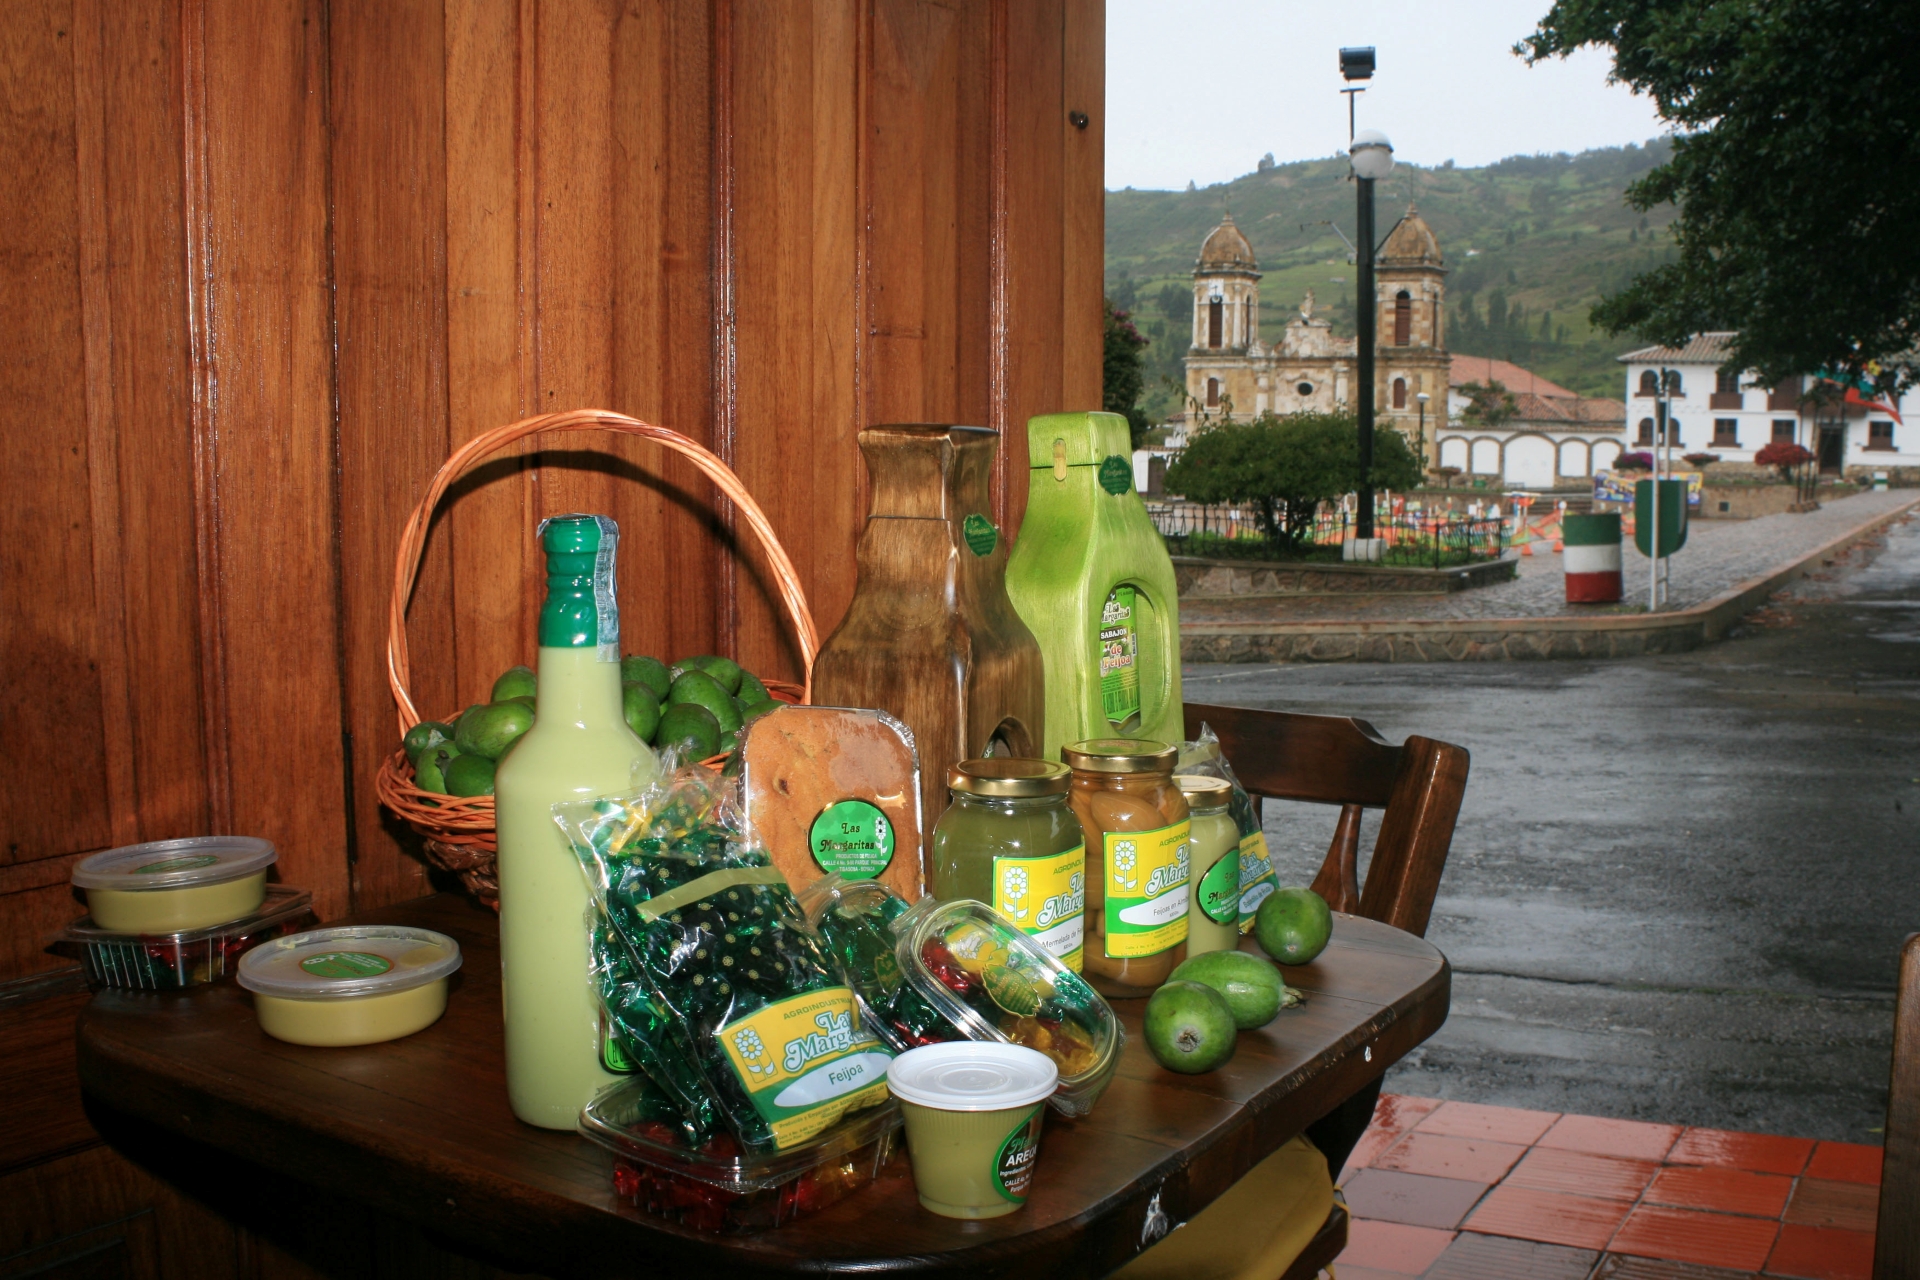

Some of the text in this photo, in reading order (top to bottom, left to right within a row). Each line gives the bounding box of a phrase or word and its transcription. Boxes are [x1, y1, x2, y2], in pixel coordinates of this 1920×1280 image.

[1110, 643, 1122, 655] de
[1103, 655, 1131, 669] Feijoa
[841, 822, 861, 835] Las
[820, 839, 875, 853] Margaritas
[1042, 933, 1070, 949] Mermelada
[1070, 931, 1077, 939] de
[828, 1064, 864, 1085] Feijoa
